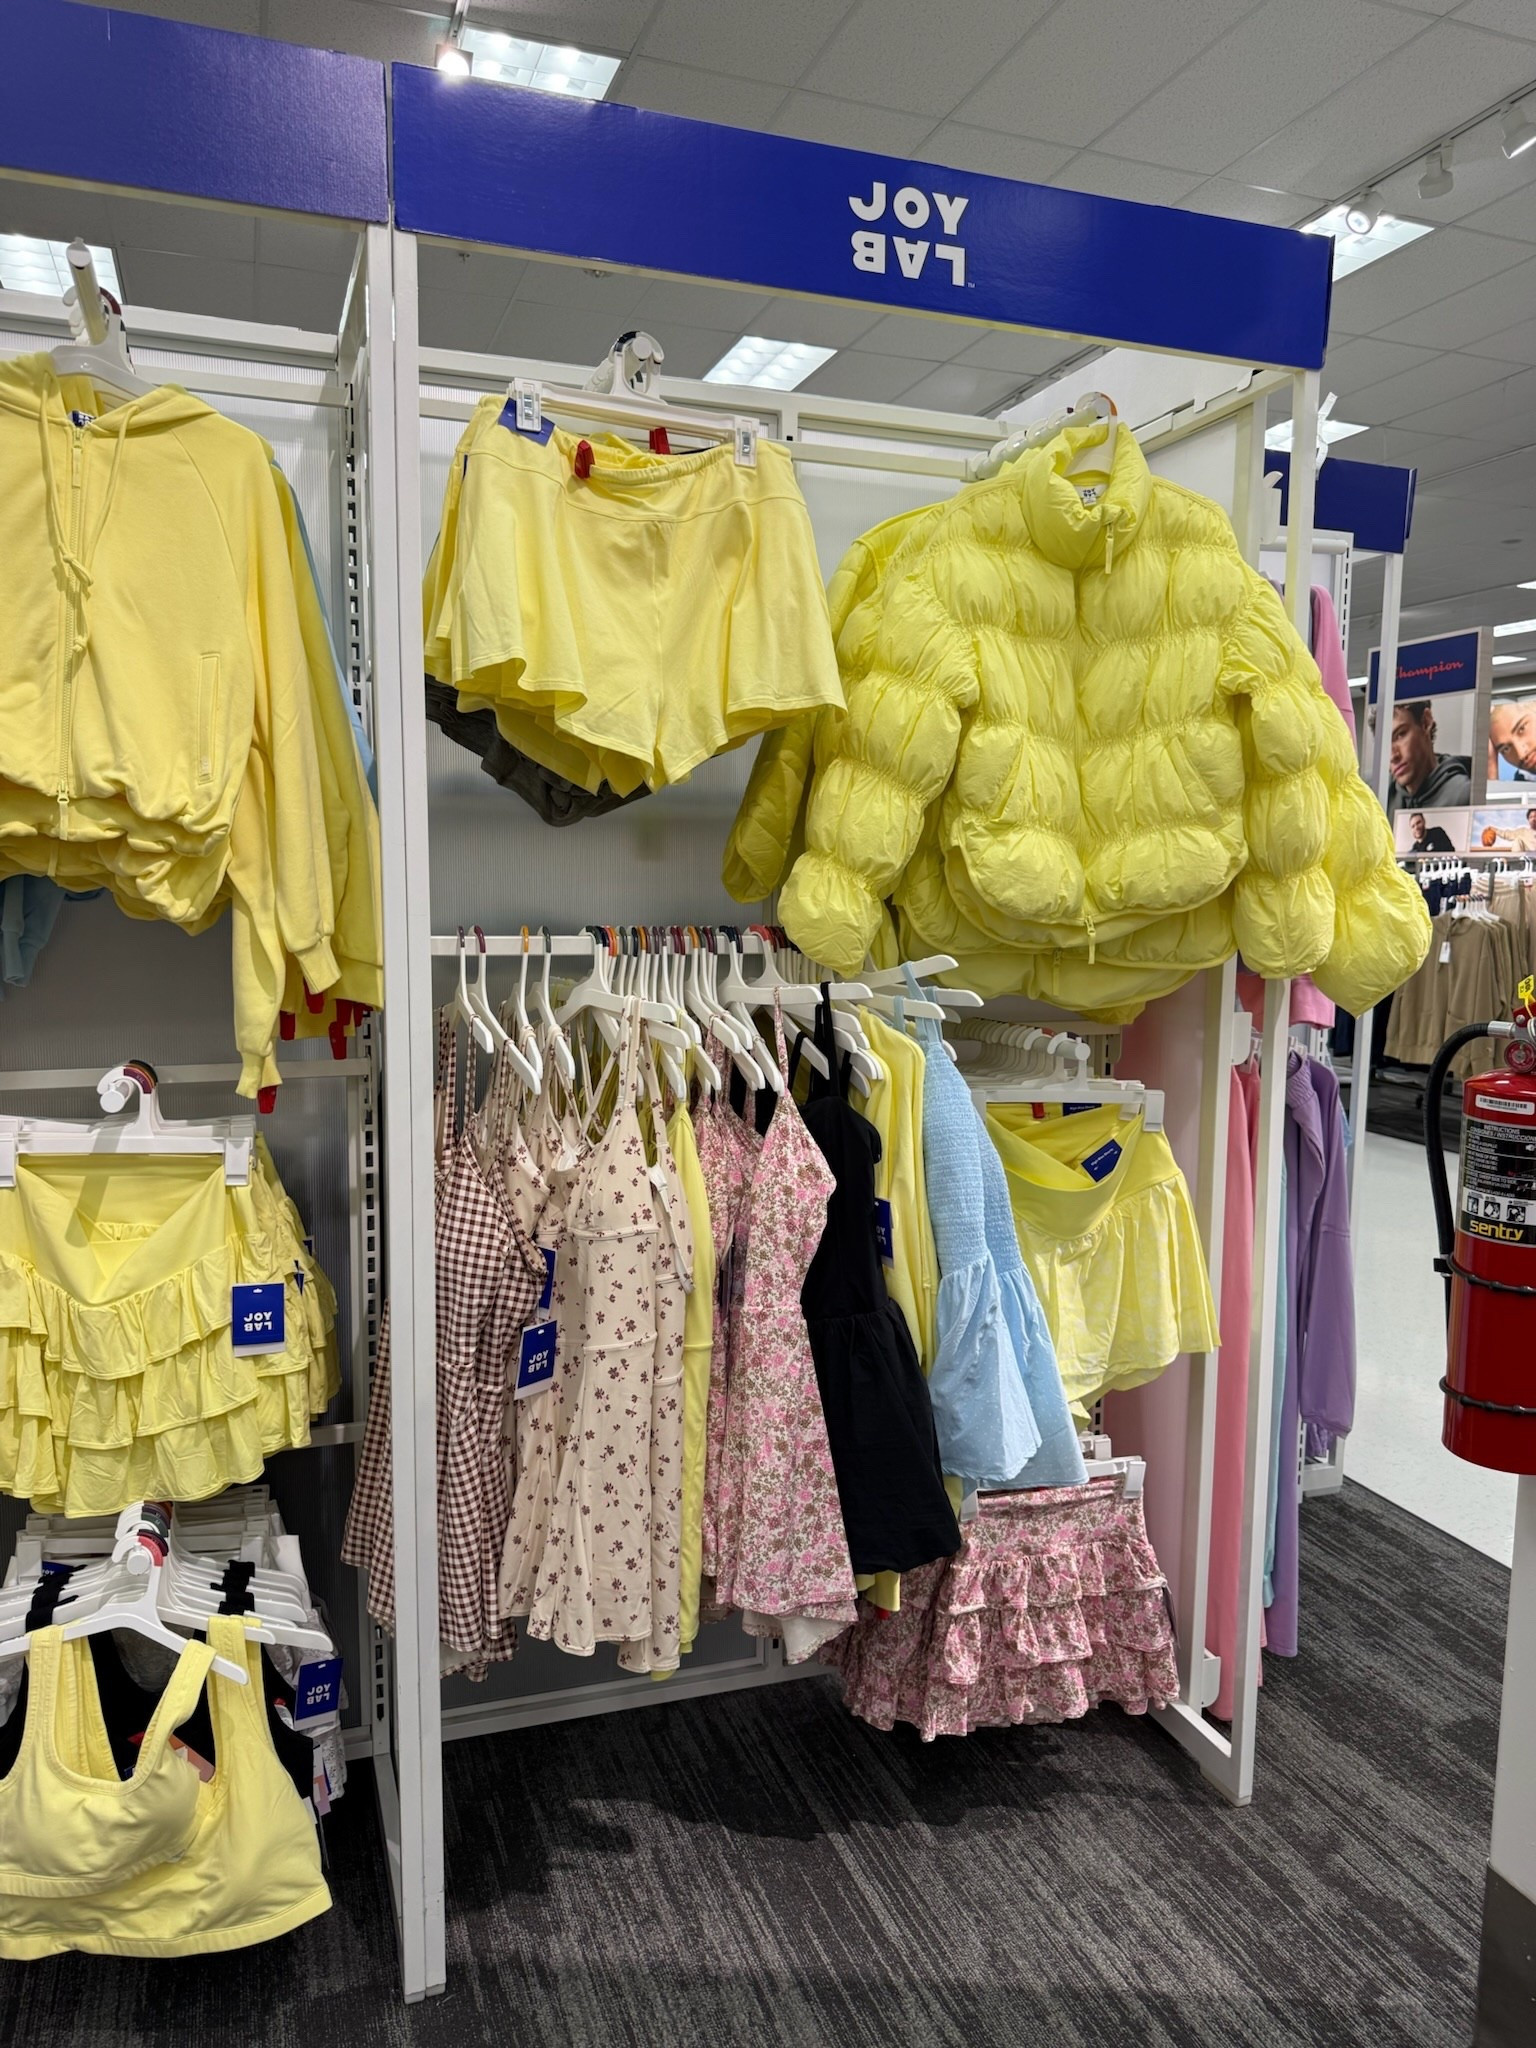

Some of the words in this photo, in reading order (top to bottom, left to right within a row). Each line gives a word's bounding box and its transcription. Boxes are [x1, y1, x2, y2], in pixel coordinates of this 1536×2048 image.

[849, 181, 969, 236] JOY
[851, 230, 966, 287] LAB
[1469, 1219, 1524, 1241] sentry
[243, 1311, 272, 1323] JOY
[244, 1320, 272, 1332] LAB
[528, 1349, 549, 1365] JOY
[527, 1359, 548, 1373] LAB
[306, 1682, 331, 1696] JOY
[306, 1691, 330, 1705] LAB
